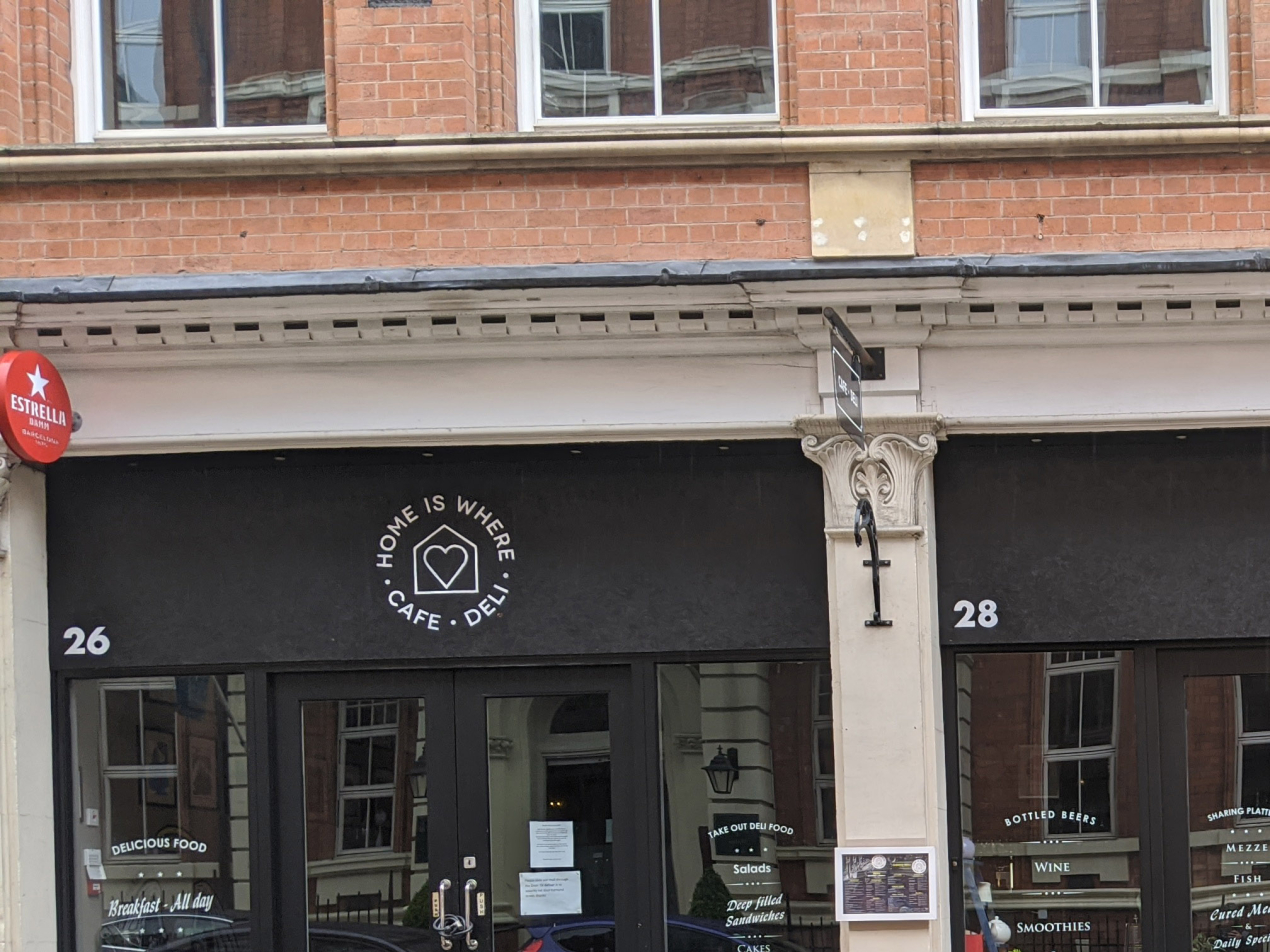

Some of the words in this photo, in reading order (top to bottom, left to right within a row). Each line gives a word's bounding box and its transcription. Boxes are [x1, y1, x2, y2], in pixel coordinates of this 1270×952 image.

[11, 394, 66, 426] ESTRELLA
[376, 504, 419, 568] HOME
[423, 495, 445, 513] IS
[457, 495, 515, 561] WHERE
[388, 590, 441, 630] CAFE
[463, 584, 508, 627] DELI
[953, 599, 998, 628] 28
[63, 626, 110, 655] 26
[1004, 810, 1056, 827] BOTTLED
[1061, 811, 1096, 826] BEERS
[1207, 807, 1244, 822] SHARING
[708, 826, 730, 839] TAKE
[730, 822, 748, 832] OUT
[749, 822, 767, 830] DELI
[768, 823, 794, 836] FOOD
[111, 837, 170, 856] DELICIOUS
[173, 838, 207, 853] FOOD
[1226, 843, 1269, 852] MEZZE
[733, 864, 772, 874] Salads
[1034, 862, 1070, 872] WINE
[1234, 874, 1262, 883] FISH
[108, 897, 161, 918] Breakfast
[170, 893, 190, 912] All
[193, 892, 215, 912] day
[726, 899, 752, 912] Deep
[754, 893, 784, 910] filled
[725, 910, 786, 927] Sandwiches
[1210, 906, 1244, 922] Cured
[1016, 922, 1091, 934] SMOOTHIES
[1213, 938, 1242, 950] Daily
